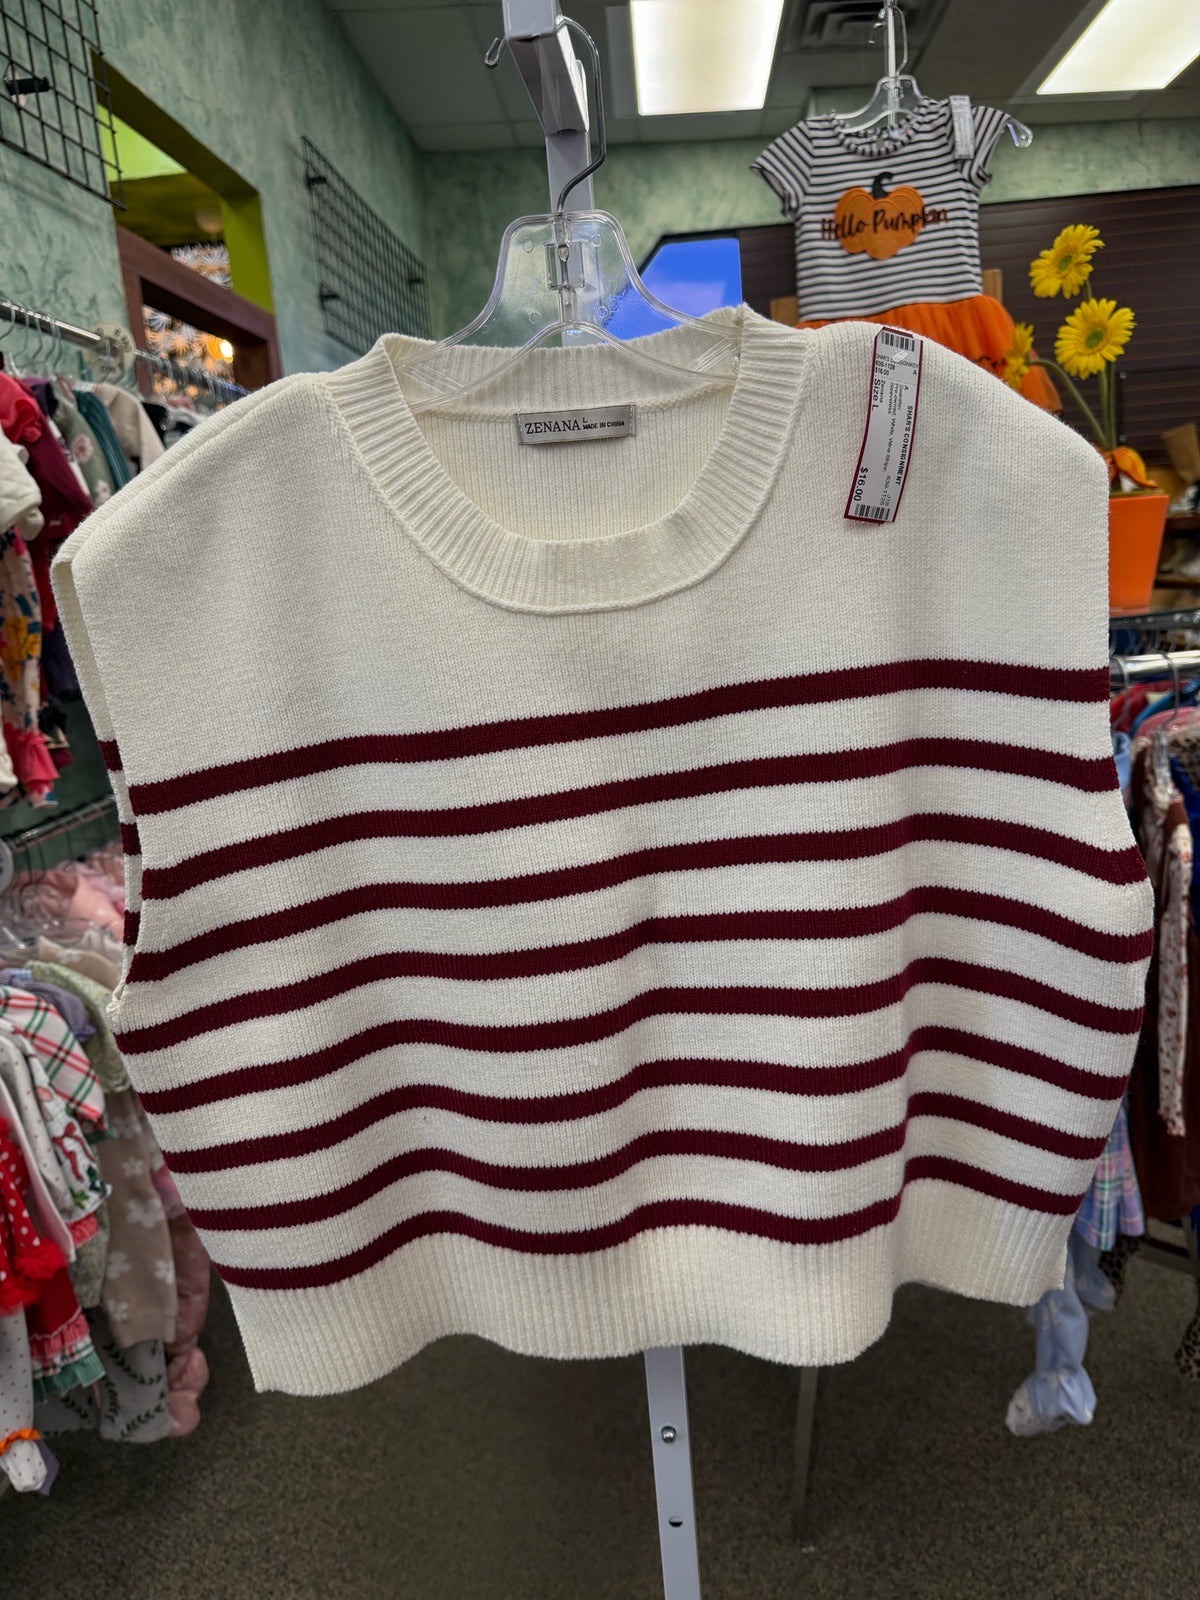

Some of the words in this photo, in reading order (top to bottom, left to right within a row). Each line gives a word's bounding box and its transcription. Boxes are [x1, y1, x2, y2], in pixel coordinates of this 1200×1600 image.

[821, 213, 868, 240] Hello
[873, 205, 949, 234] Pumpkin
[872, 378, 881, 402] Size
[524, 419, 581, 434] ZENANA
[583, 422, 598, 430] MADE
[905, 406, 913, 432] SHAR'S
[896, 433, 910, 486] CONSIGNMENT
[853, 466, 869, 502] $16.00
